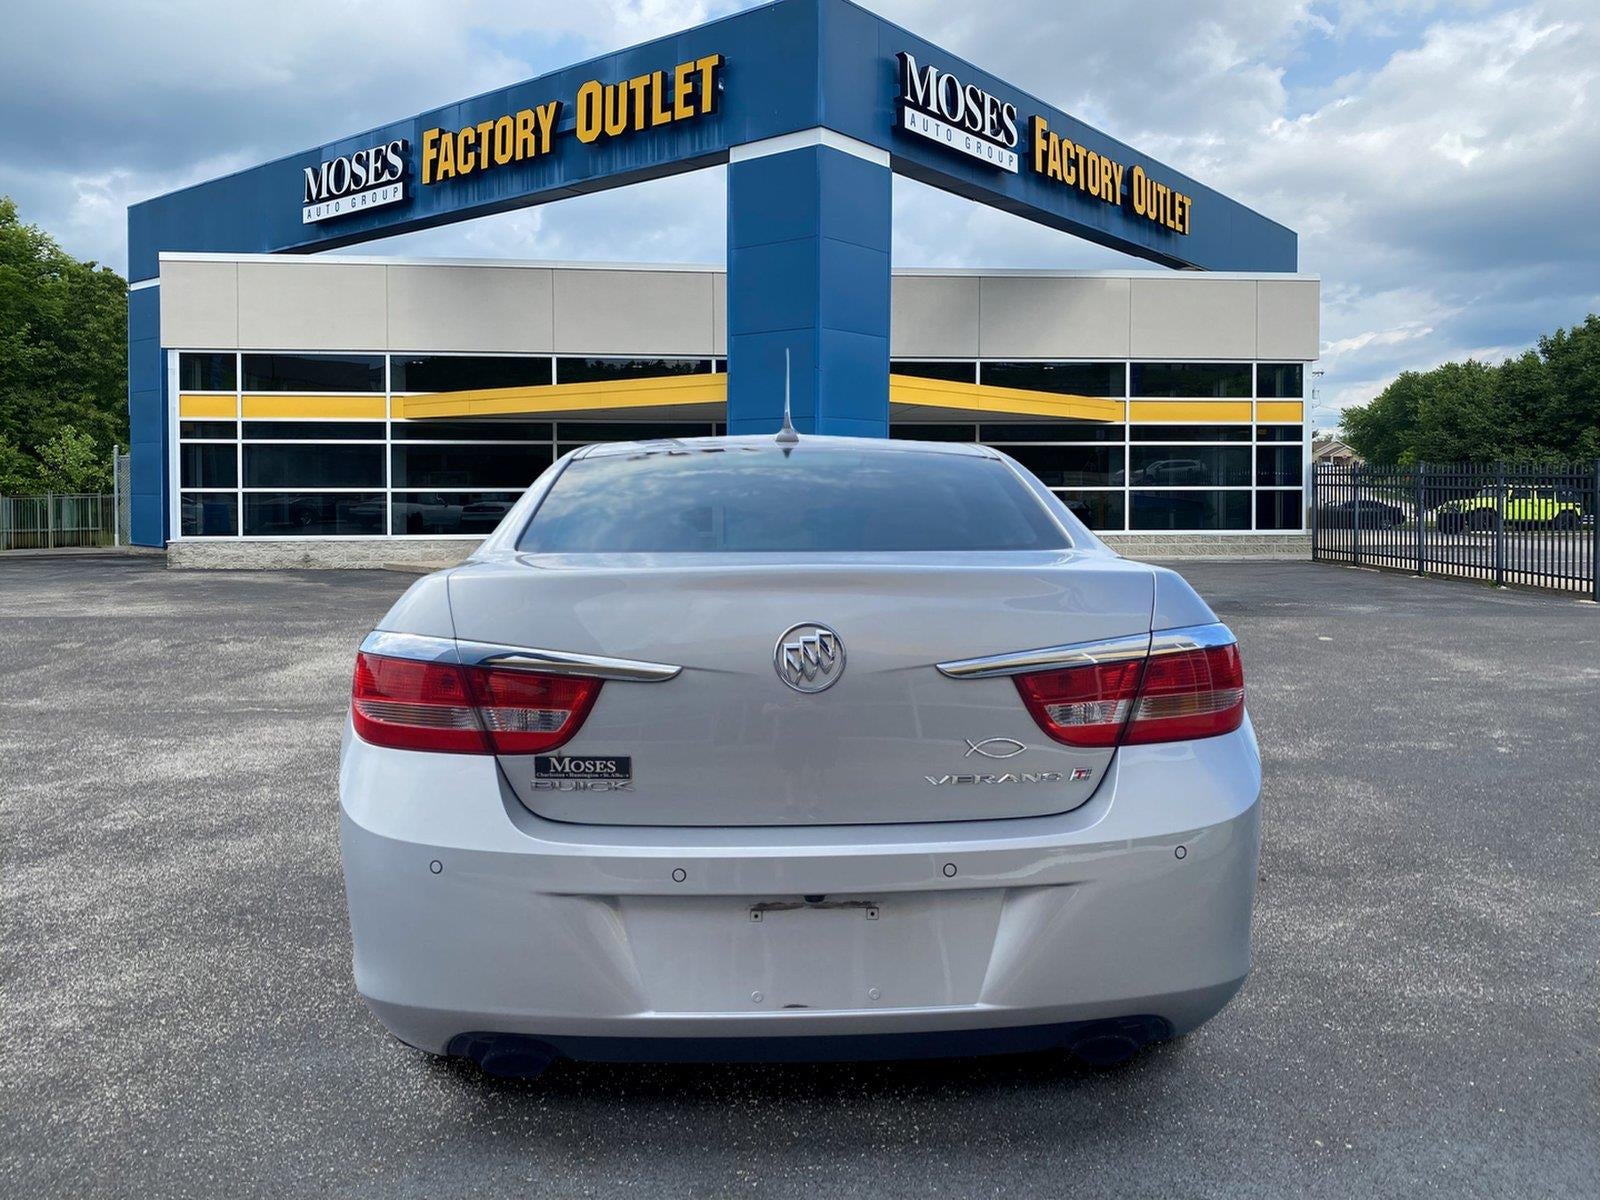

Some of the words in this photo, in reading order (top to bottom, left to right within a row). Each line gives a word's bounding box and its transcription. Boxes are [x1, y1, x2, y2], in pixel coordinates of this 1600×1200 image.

[421, 101, 559, 185] FACTORY
[576, 53, 719, 144] OUTLET
[903, 52, 1018, 148] MOSES
[909, 113, 953, 143] AUTO
[964, 136, 1014, 168] GROUP
[302, 138, 404, 203] MOSES
[1034, 114, 1125, 206] FACTORY
[1132, 165, 1192, 235] OUTLET
[307, 202, 341, 221] AUTO
[350, 186, 400, 208] GROUP
[531, 780, 634, 792] BUICK
[548, 757, 616, 773] MOSES
[924, 772, 1063, 786] VERANO
